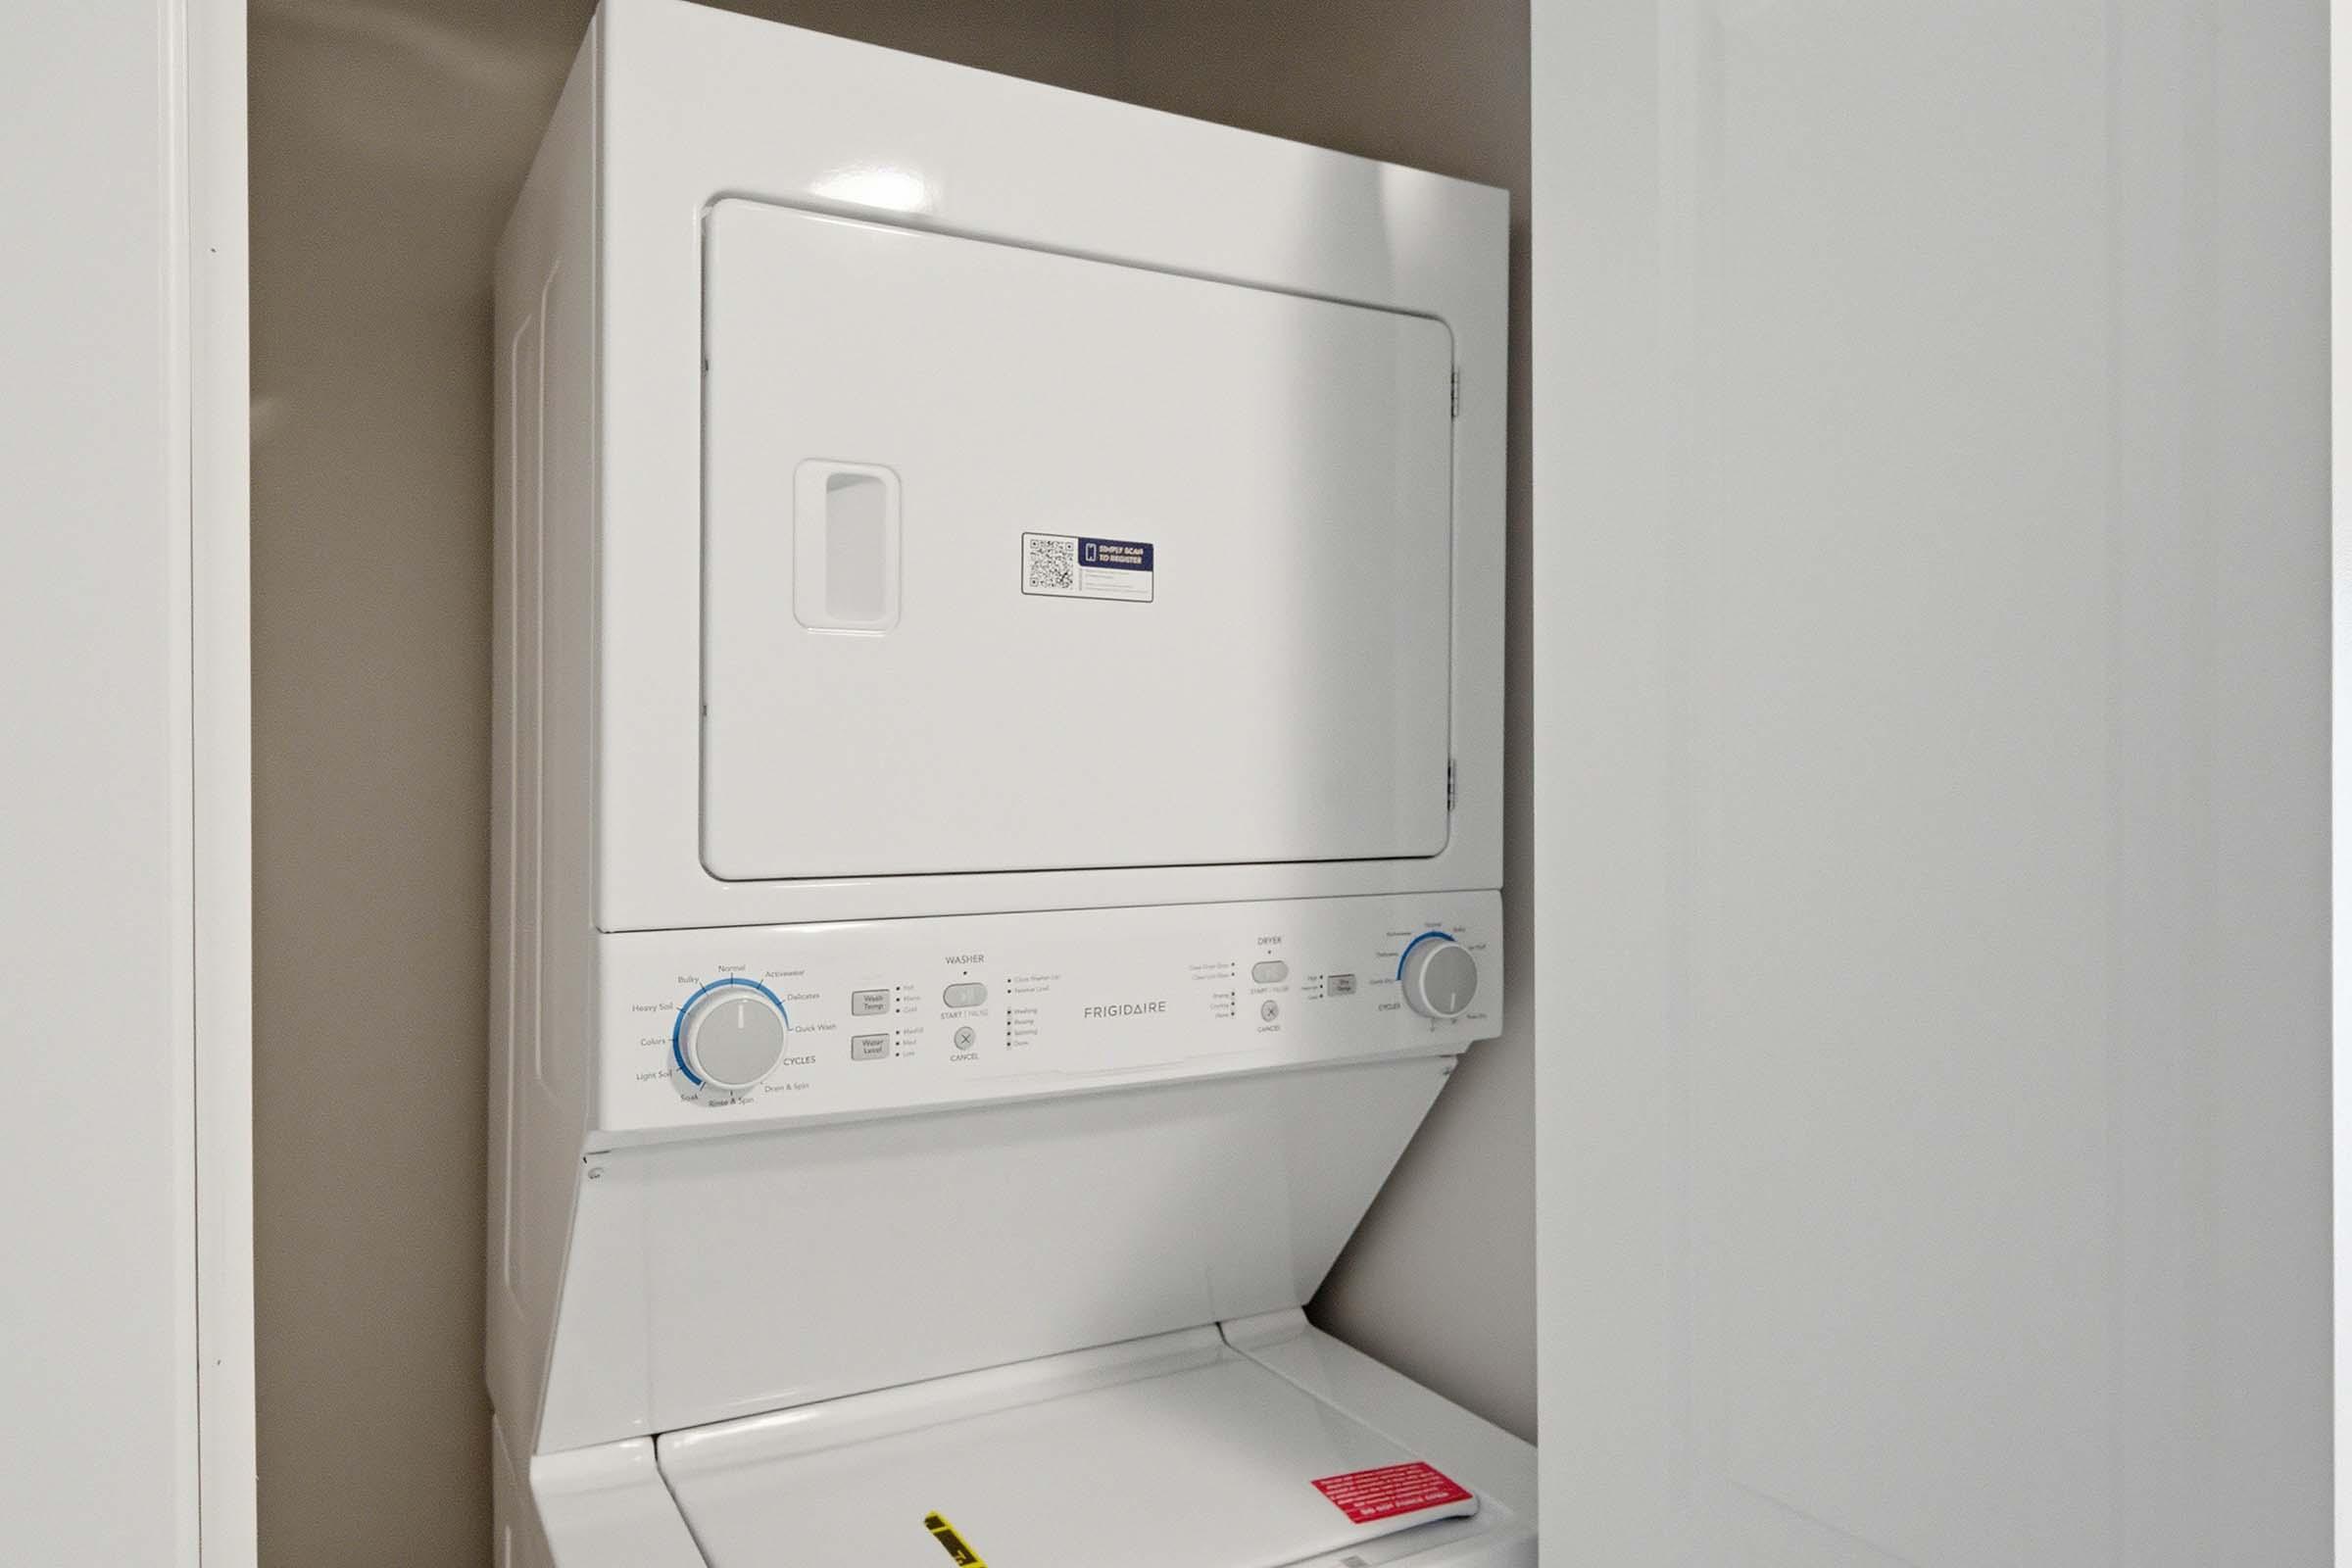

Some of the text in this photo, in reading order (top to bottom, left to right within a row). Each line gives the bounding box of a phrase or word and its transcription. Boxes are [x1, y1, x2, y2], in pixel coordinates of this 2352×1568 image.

[1099, 545, 1144, 556] SIMPLY SCAN
[1110, 555, 1142, 564] REGISTER
[1257, 936, 1282, 946] DRYER
[945, 955, 984, 964] WASHER
[718, 964, 746, 973] Normal
[764, 969, 805, 978] Activewear
[677, 975, 700, 984] Bulky
[787, 993, 820, 1002] Delicates
[632, 1002, 674, 1012] Heavy Soil
[1084, 1001, 1167, 1018] FRIGIDAIRE
[941, 1010, 962, 1019] START
[795, 1024, 815, 1033] Quick
[641, 1038, 665, 1047] Colors
[784, 1054, 816, 1066] CYCLES
[950, 1053, 979, 1062] CANCEL
[636, 1068, 673, 1082] Light Soil
[764, 1083, 785, 1093] Drain
[794, 1081, 809, 1091] Spin
[680, 1093, 699, 1102] Soak
[709, 1099, 728, 1107] Rinse
[738, 1096, 755, 1106] Spin
